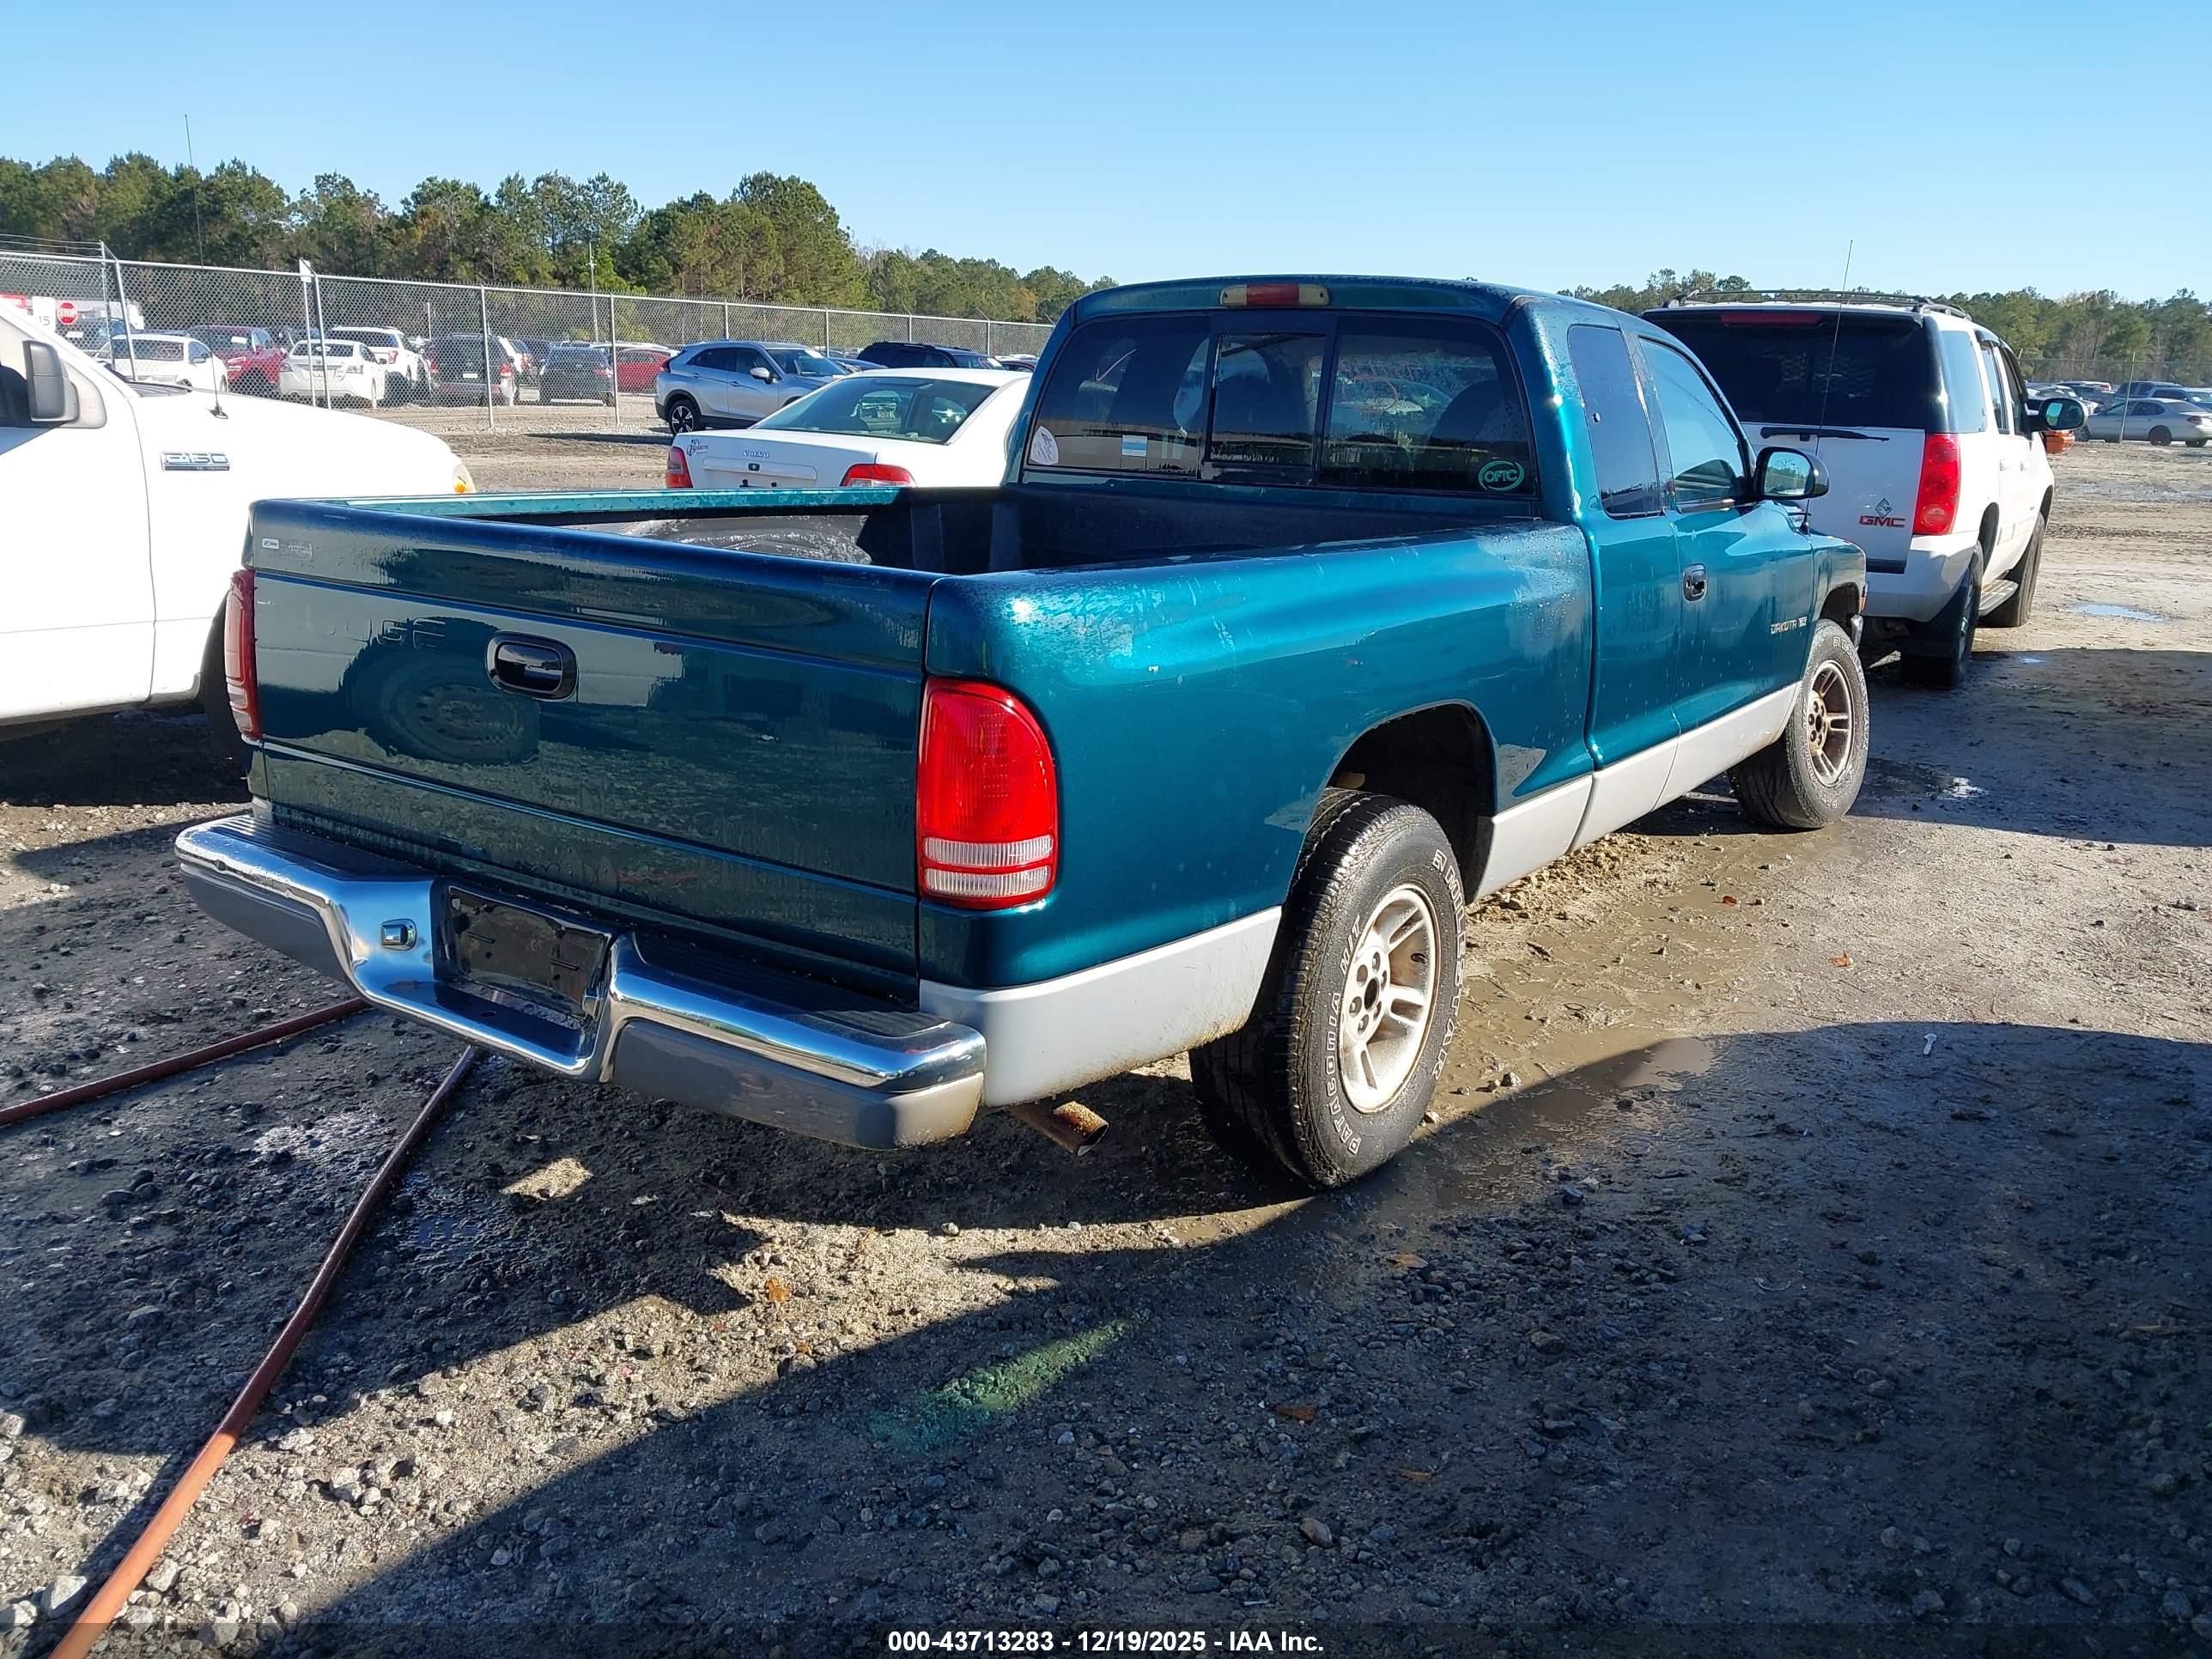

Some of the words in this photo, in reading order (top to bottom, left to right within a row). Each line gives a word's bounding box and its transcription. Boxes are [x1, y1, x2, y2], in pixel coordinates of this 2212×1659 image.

[58, 308, 76, 318] STOP
[39, 316, 51, 326] 15
[743, 449, 770, 459] VOLVO
[1484, 469, 1518, 483] OFTC
[1859, 515, 1905, 528] GMC
[1771, 619, 1797, 635] DAKOTA
[1431, 866, 1466, 1080] MILESTAR
[1326, 993, 1362, 1155] PATAGONIA
